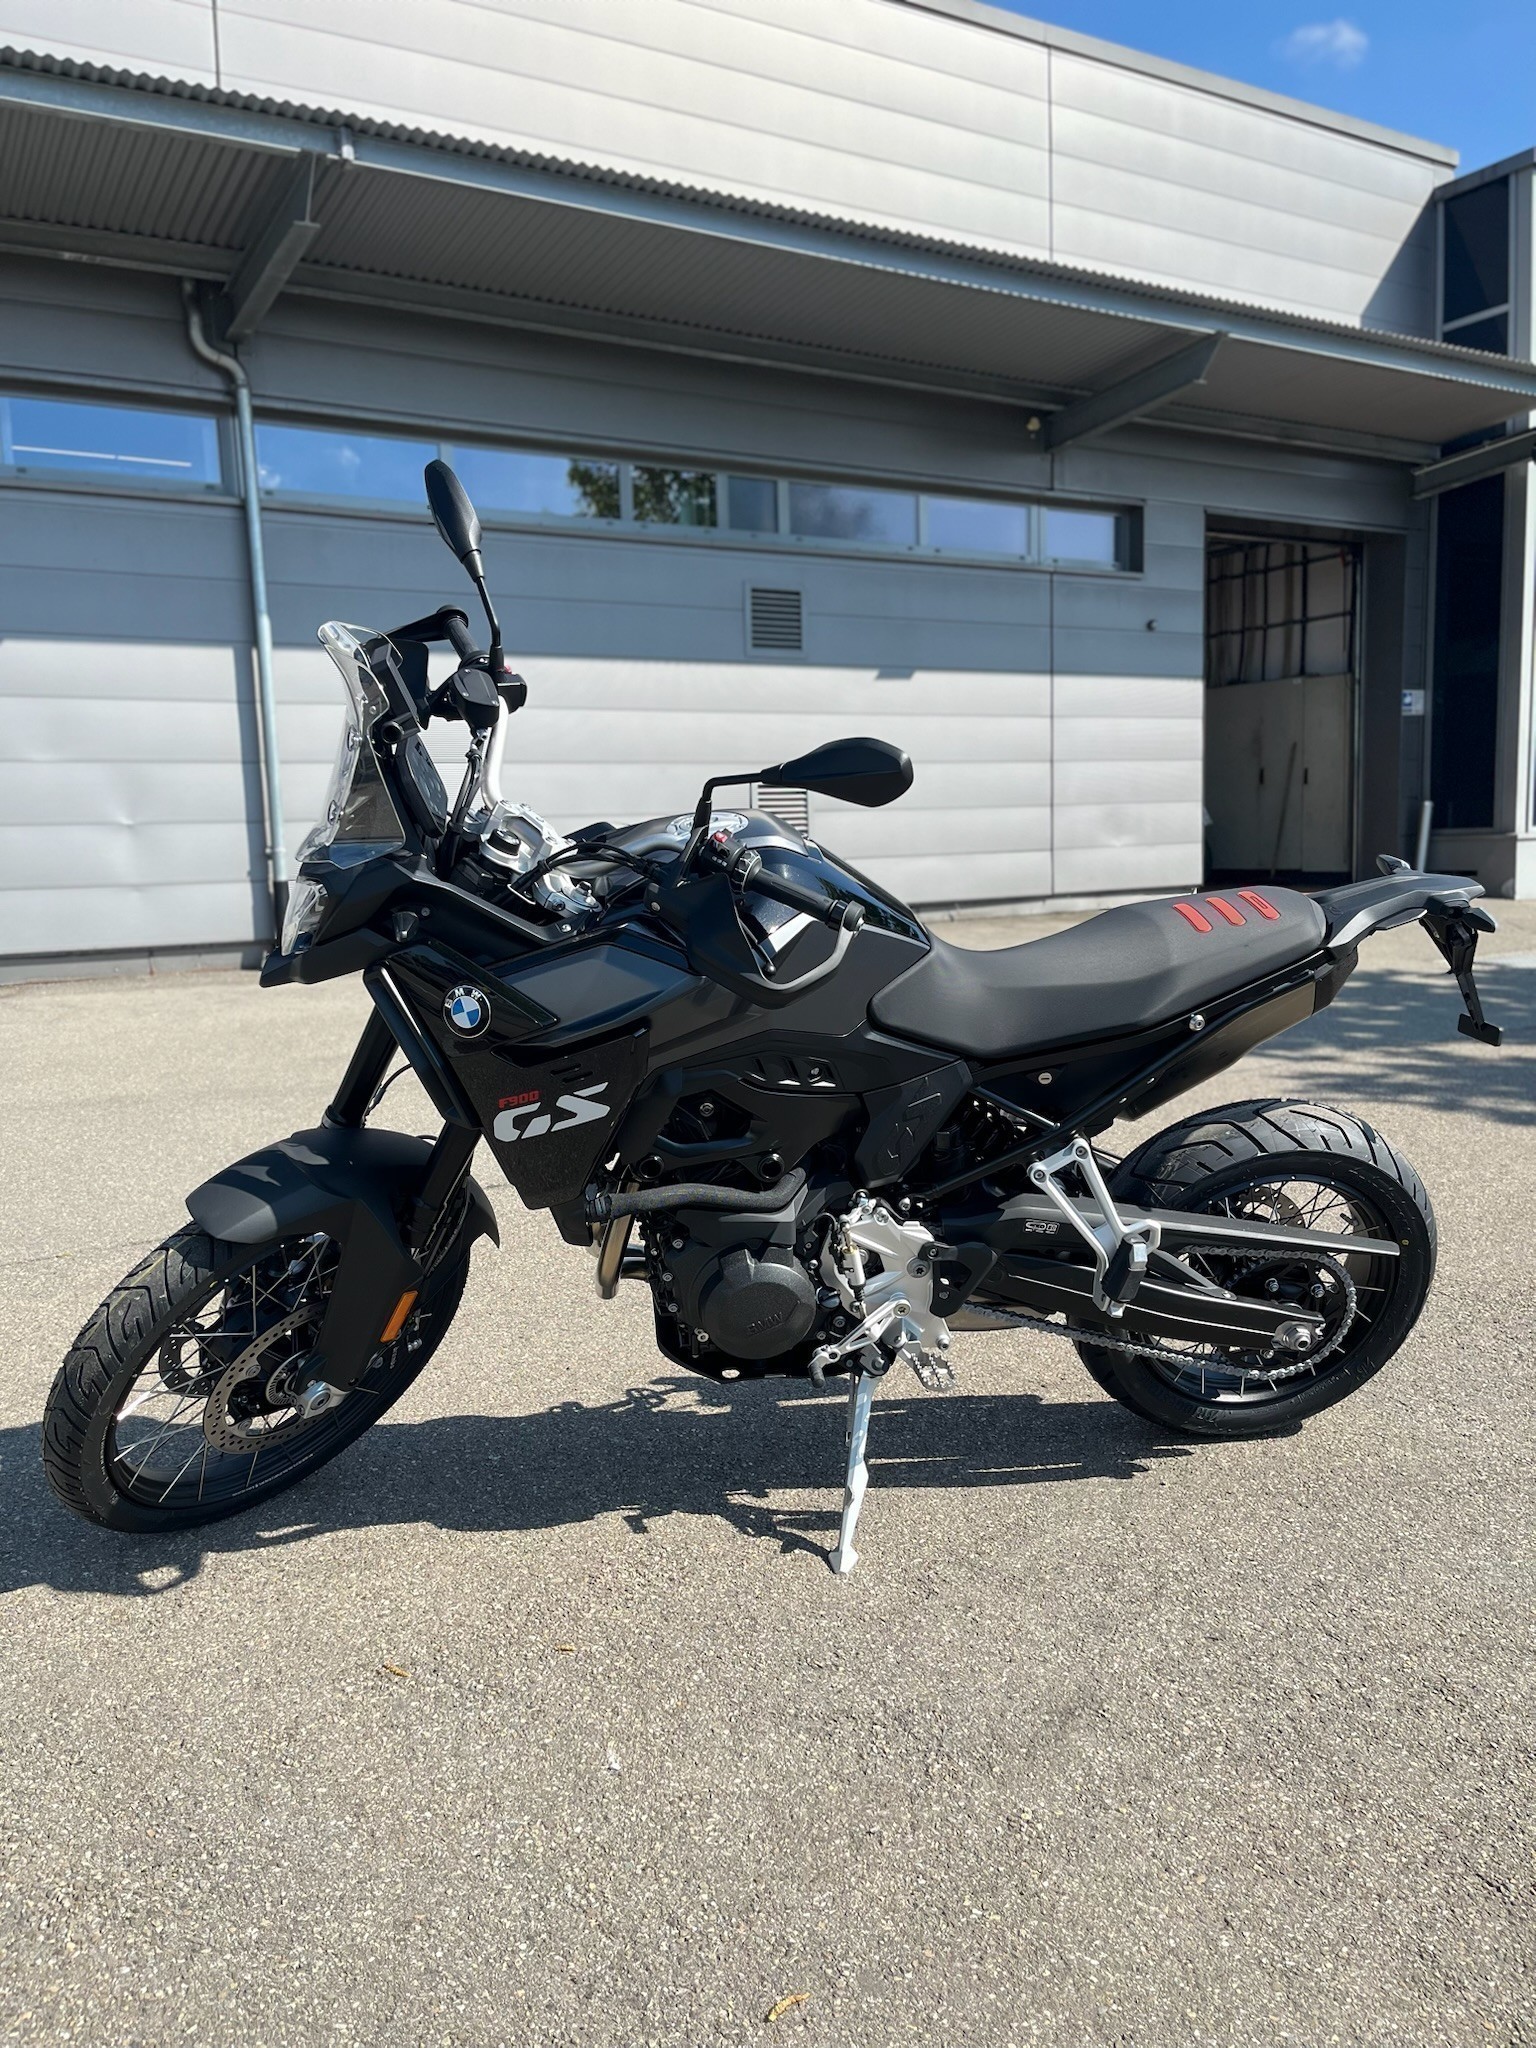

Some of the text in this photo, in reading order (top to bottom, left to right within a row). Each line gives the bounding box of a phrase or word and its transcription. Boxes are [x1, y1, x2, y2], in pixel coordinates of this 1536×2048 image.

[493, 1082, 610, 1142] GS
[498, 1090, 540, 1109] F900
[746, 1311, 783, 1336] BMW
